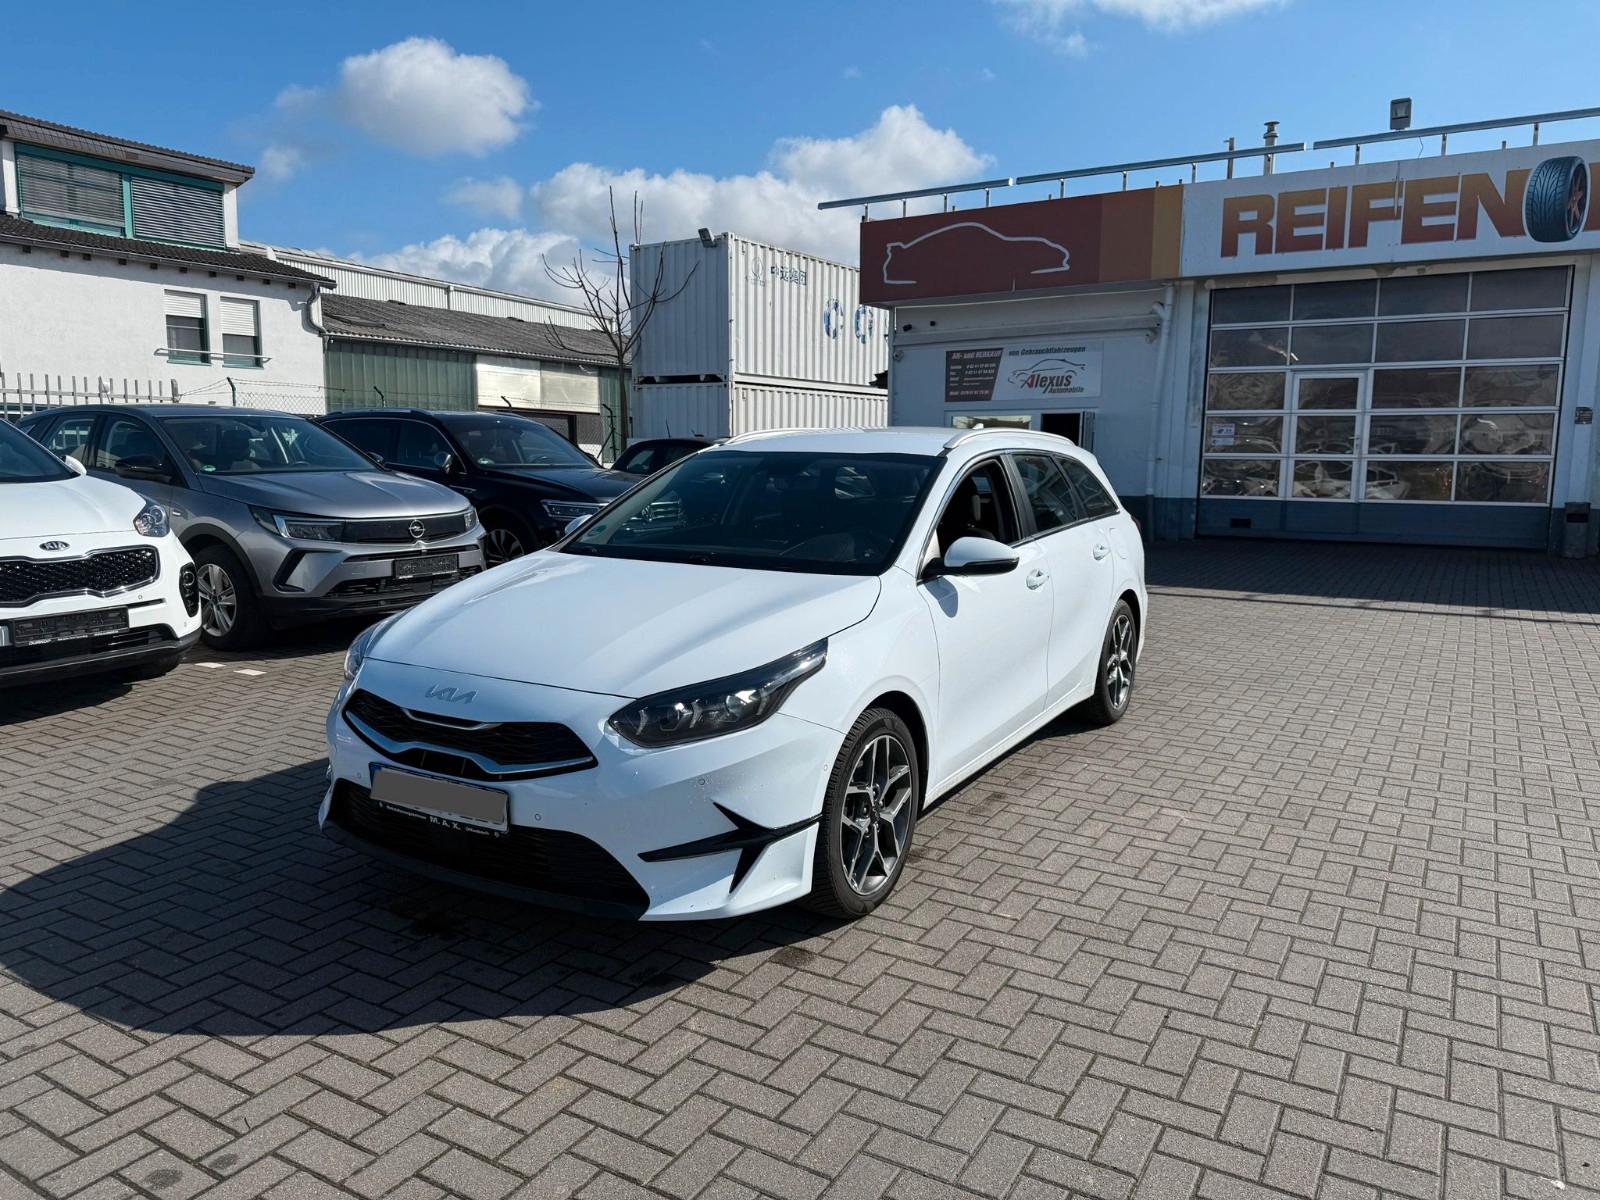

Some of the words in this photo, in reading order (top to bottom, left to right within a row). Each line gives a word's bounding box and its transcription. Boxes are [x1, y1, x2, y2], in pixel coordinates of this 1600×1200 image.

[1220, 167, 1532, 257] REIFEN
[1020, 346, 1086, 356] Gebrauchtfahrzeugen
[1020, 373, 1073, 394] Alexus
[44, 541, 68, 550] KIA
